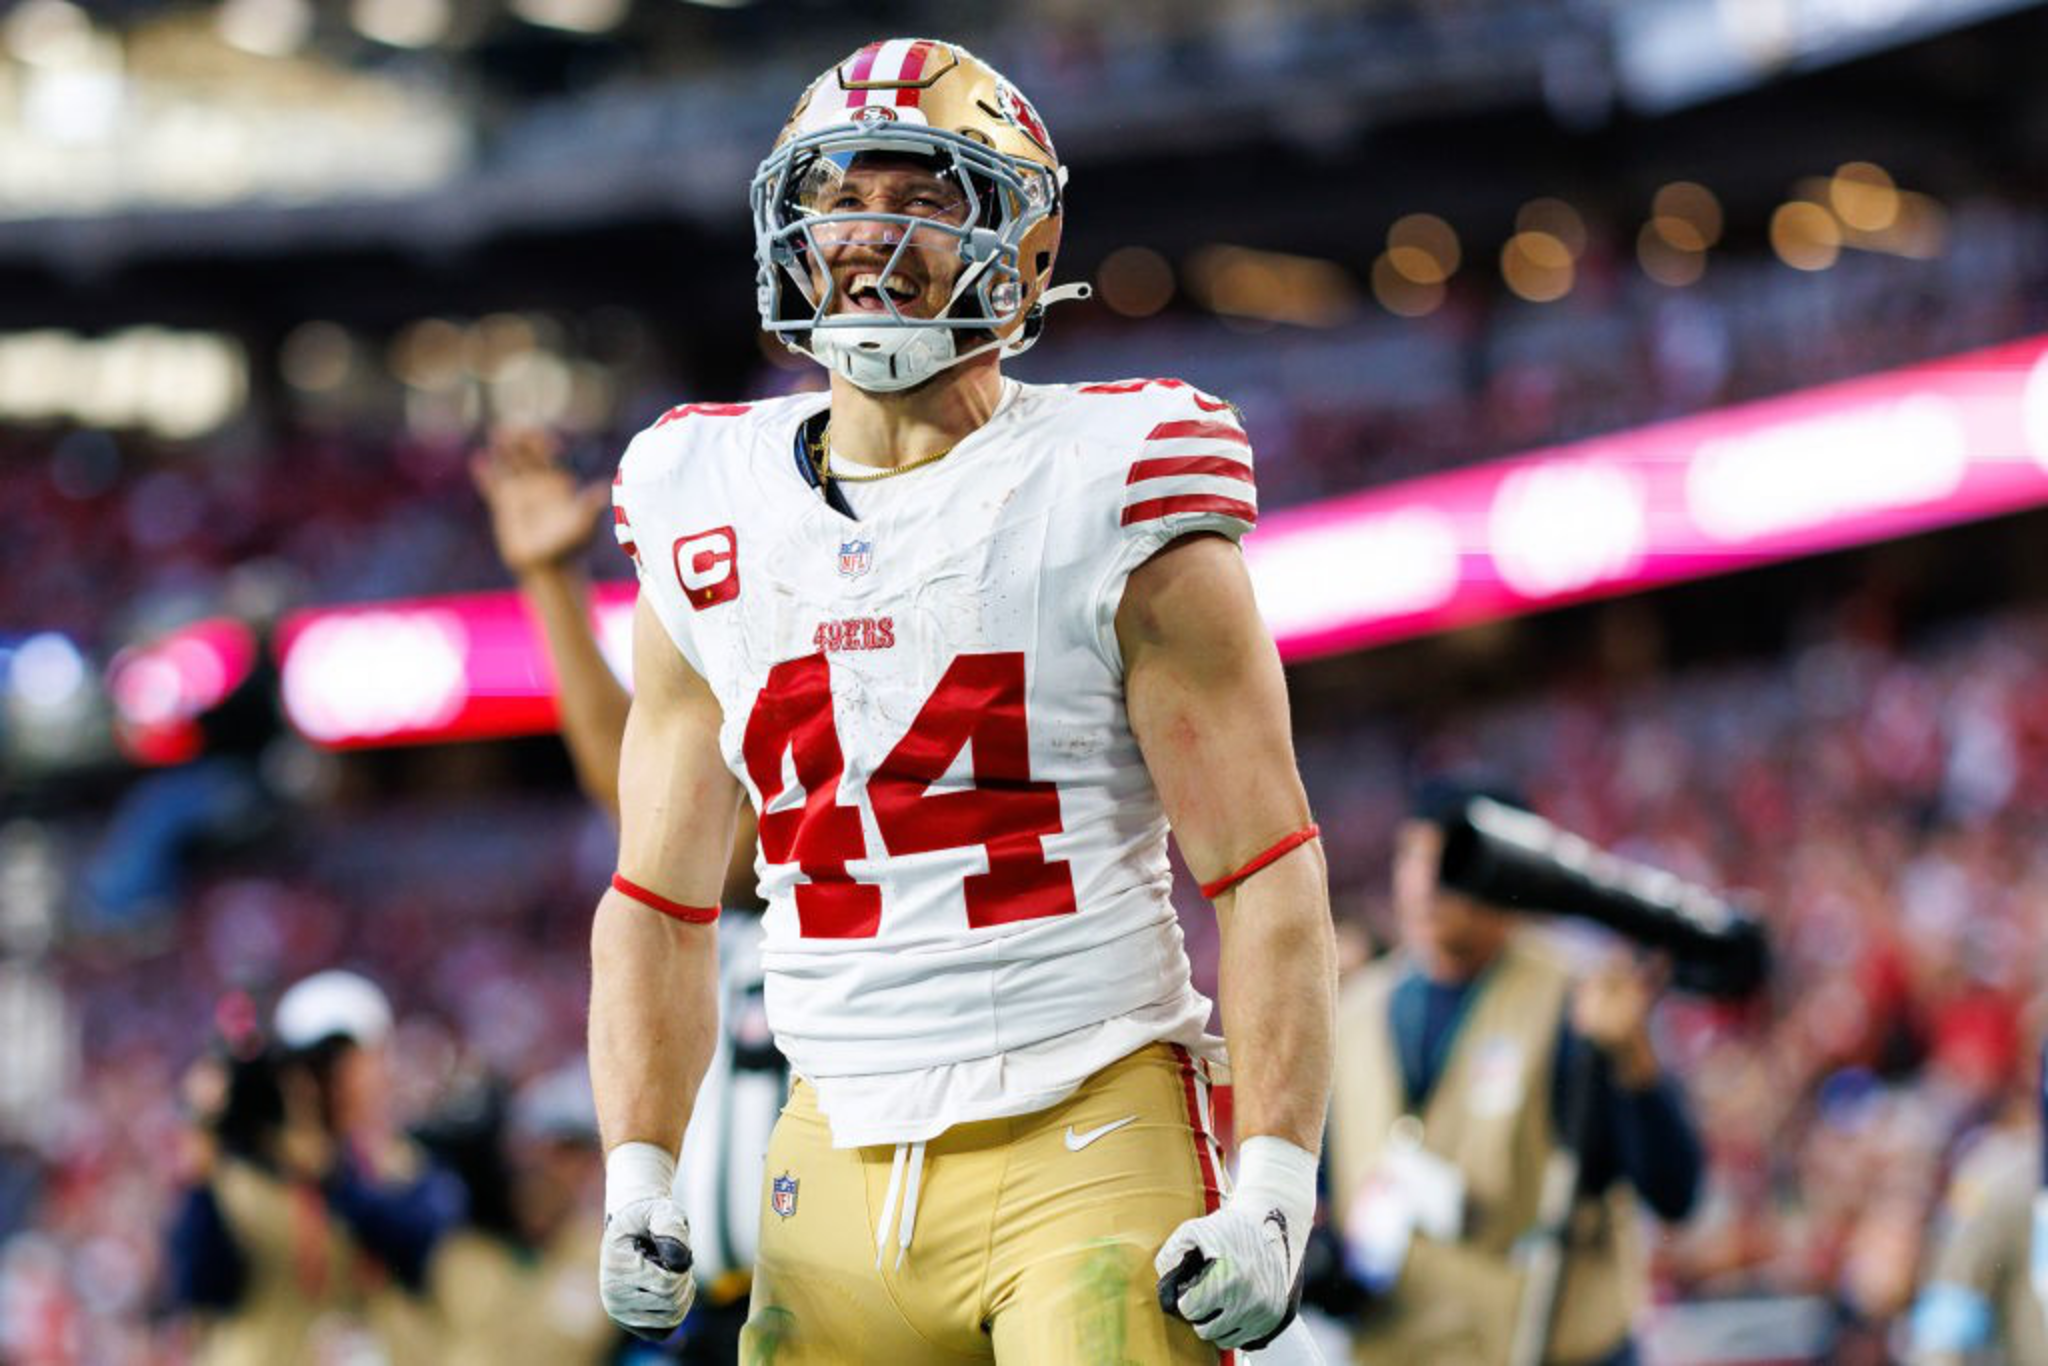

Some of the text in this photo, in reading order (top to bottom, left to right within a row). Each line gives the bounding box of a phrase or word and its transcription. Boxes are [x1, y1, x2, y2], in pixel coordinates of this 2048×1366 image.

[677, 533, 732, 591] C
[812, 616, 895, 652] 49ERS
[742, 650, 1077, 939] 44
